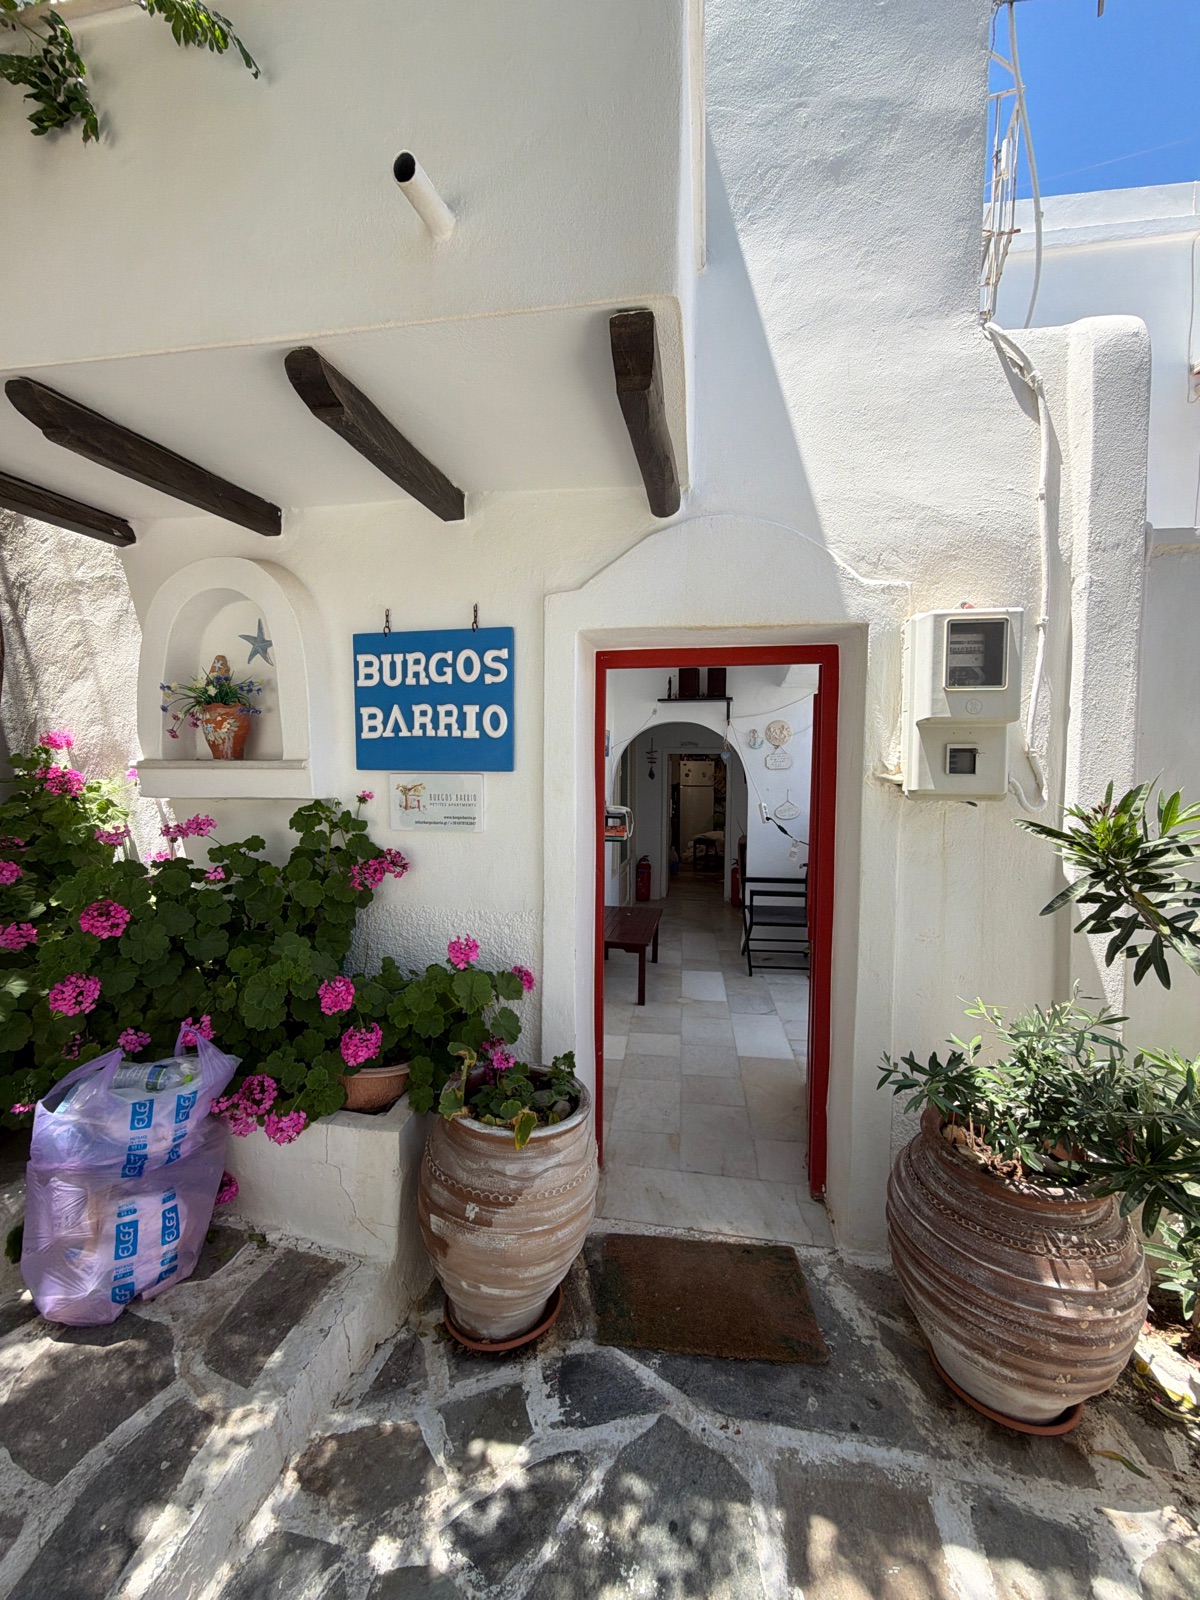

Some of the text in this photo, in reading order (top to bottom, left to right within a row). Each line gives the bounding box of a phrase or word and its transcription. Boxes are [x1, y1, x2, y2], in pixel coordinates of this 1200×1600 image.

[356, 648, 509, 687] BURGOS
[359, 703, 509, 739] BARRIO
[429, 793, 477, 802] BURGOS BARRIO
[134, 1101, 151, 1128] ELE
